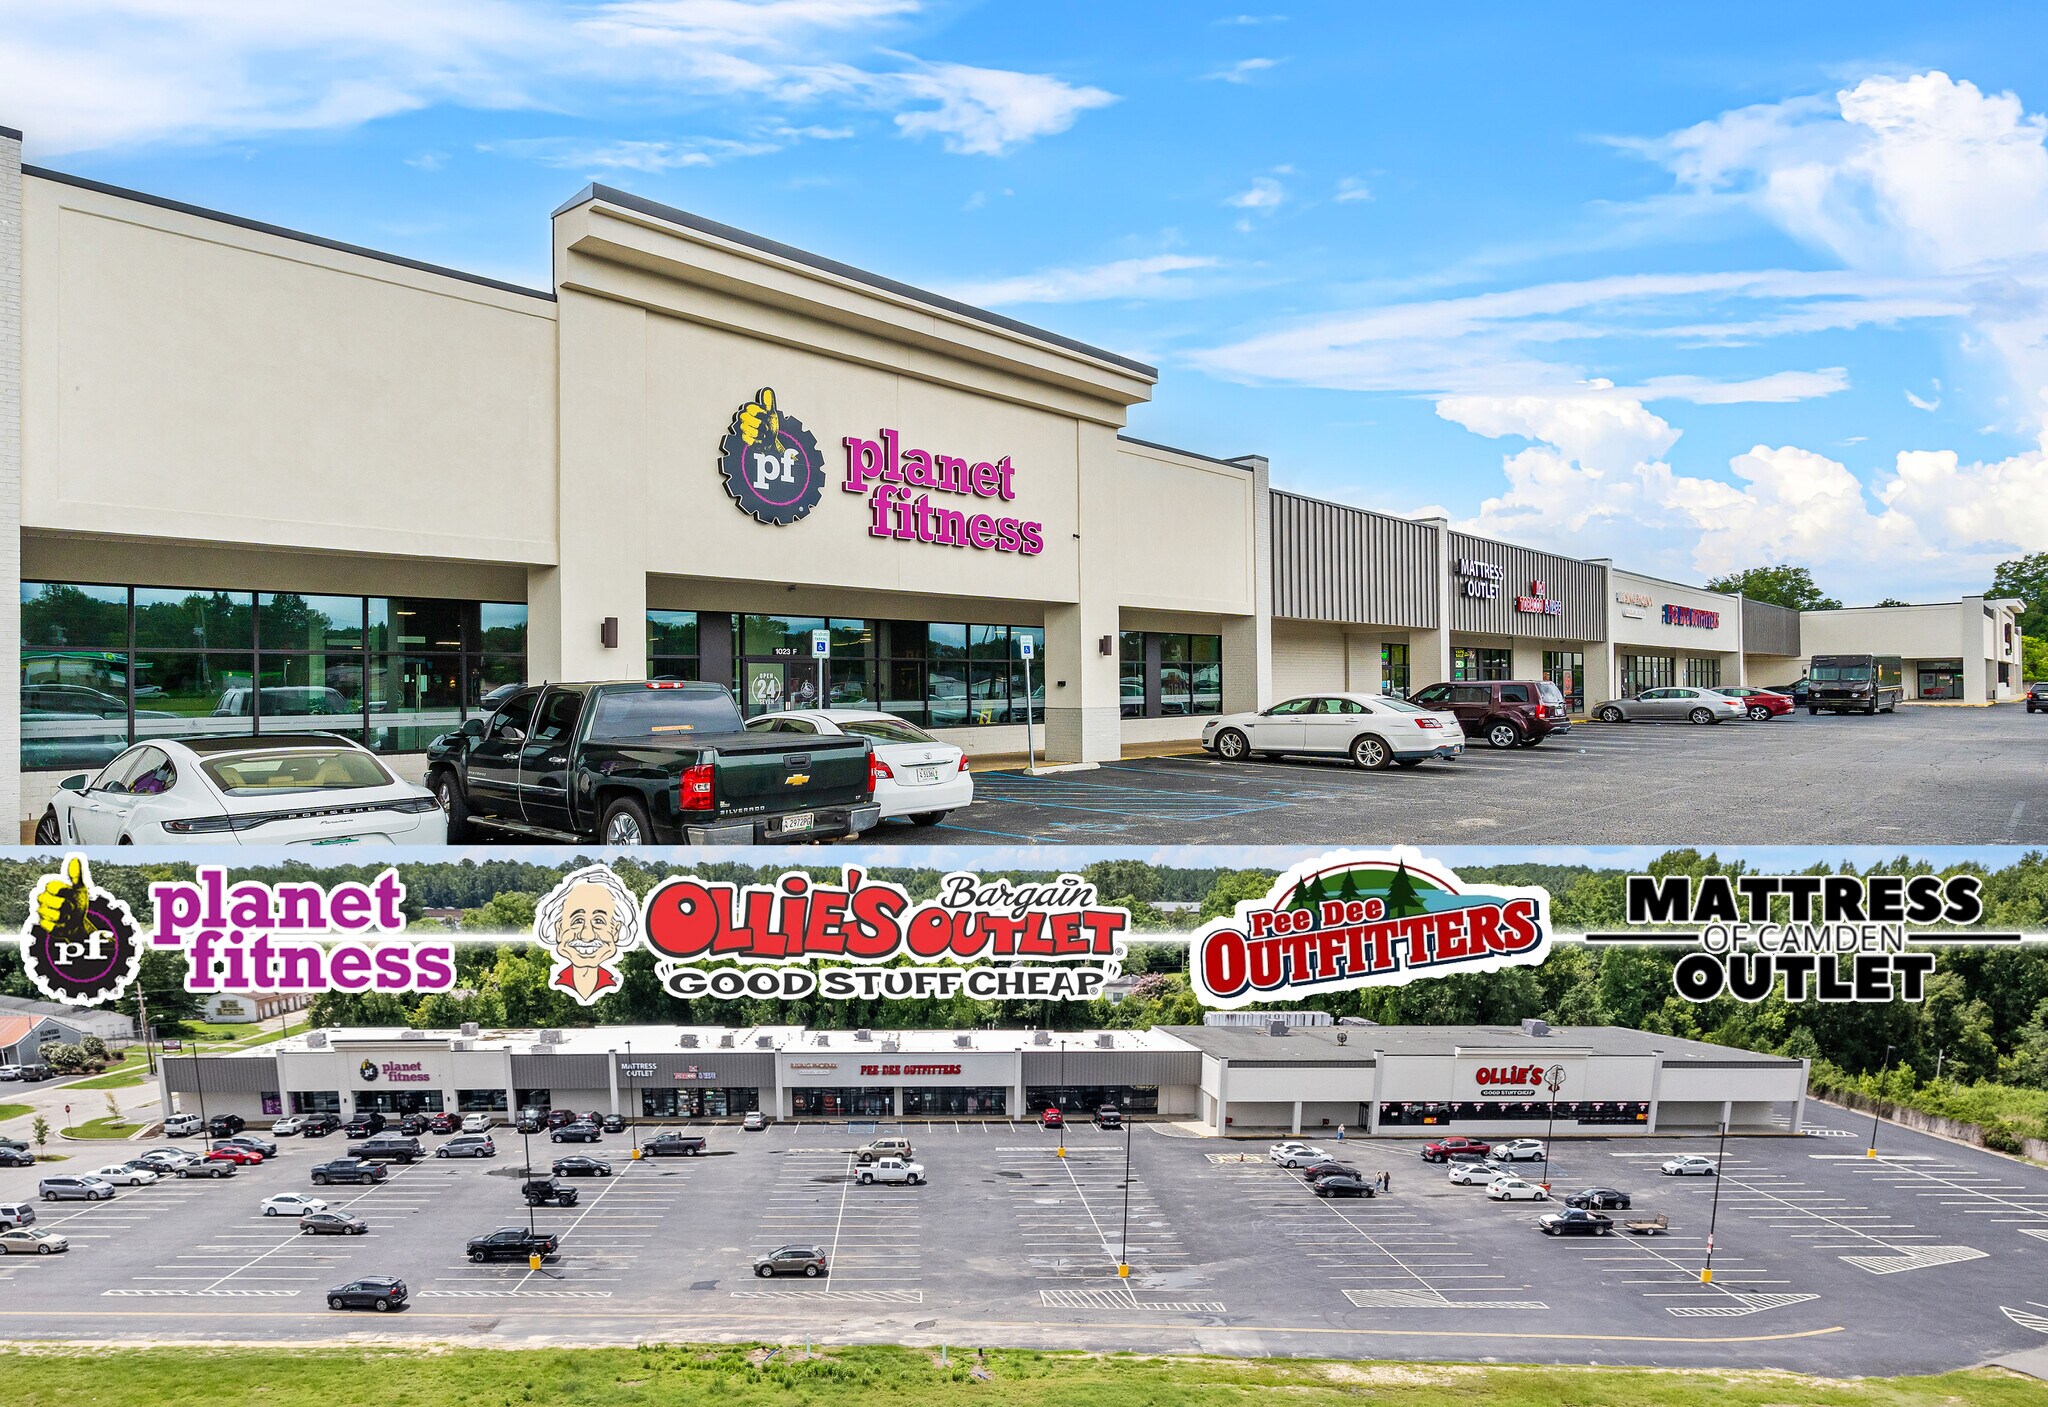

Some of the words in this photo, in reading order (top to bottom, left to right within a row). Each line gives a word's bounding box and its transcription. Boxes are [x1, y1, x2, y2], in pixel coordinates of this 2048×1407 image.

[753, 449, 799, 490] pf
[842, 427, 1016, 501] planet
[868, 484, 1044, 556] fitness
[1460, 558, 1504, 581] MATTRESS
[1467, 580, 1500, 600] OUTLET
[757, 679, 776, 699] 24
[288, 806, 376, 819] PORSCHE
[719, 805, 765, 815] SILVERADO
[382, 1061, 422, 1074] planet
[621, 1062, 657, 1070] MATTRESS
[860, 1064, 880, 1075] PEE
[882, 1064, 901, 1075] DEE
[903, 1064, 962, 1075] OUTFITTERS
[1475, 1064, 1544, 1086] OLLIE'S
[388, 1071, 430, 1082] fitness
